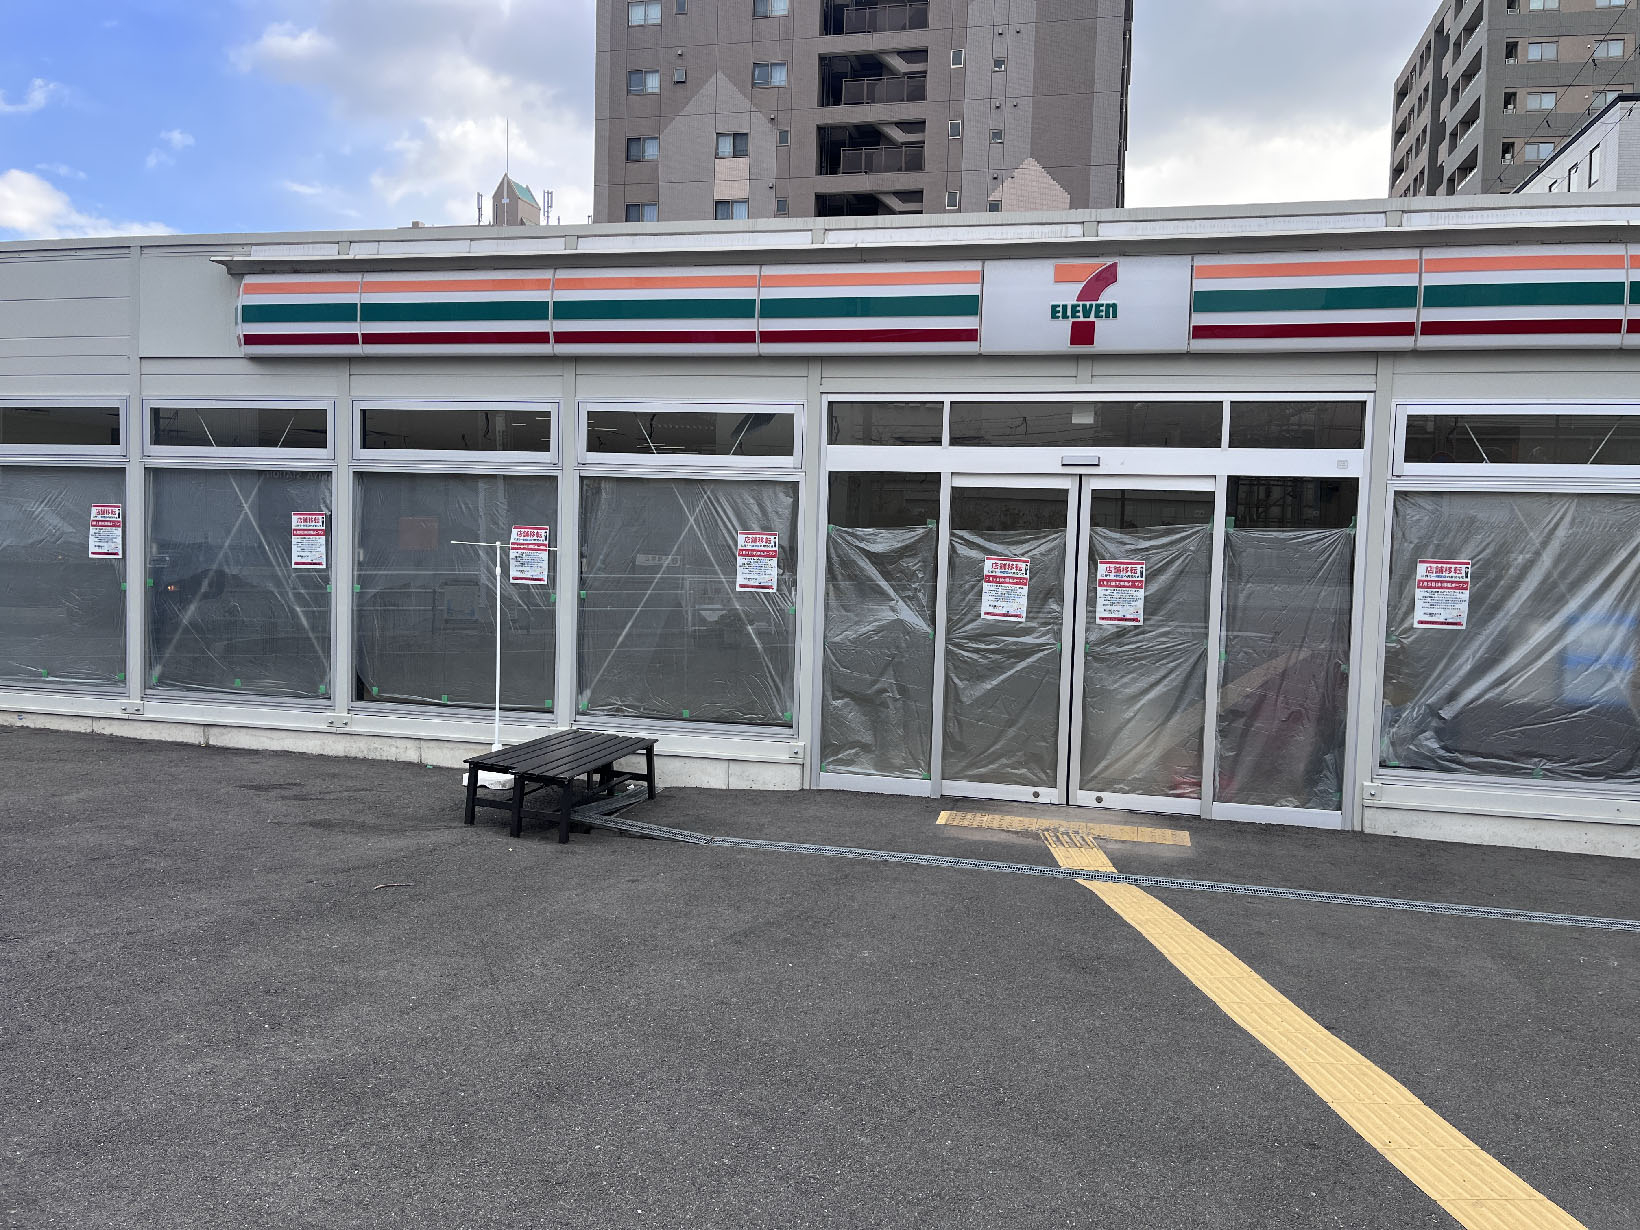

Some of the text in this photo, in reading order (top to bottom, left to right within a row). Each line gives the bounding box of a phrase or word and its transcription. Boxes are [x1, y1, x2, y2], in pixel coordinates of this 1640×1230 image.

[1054, 261, 1118, 345] 7
[1051, 303, 1118, 320] ELEVEN
[992, 562, 1023, 571] 店舗移転
[1105, 566, 1138, 574] 店舗移転
[1425, 566, 1463, 574] 店舗移転
